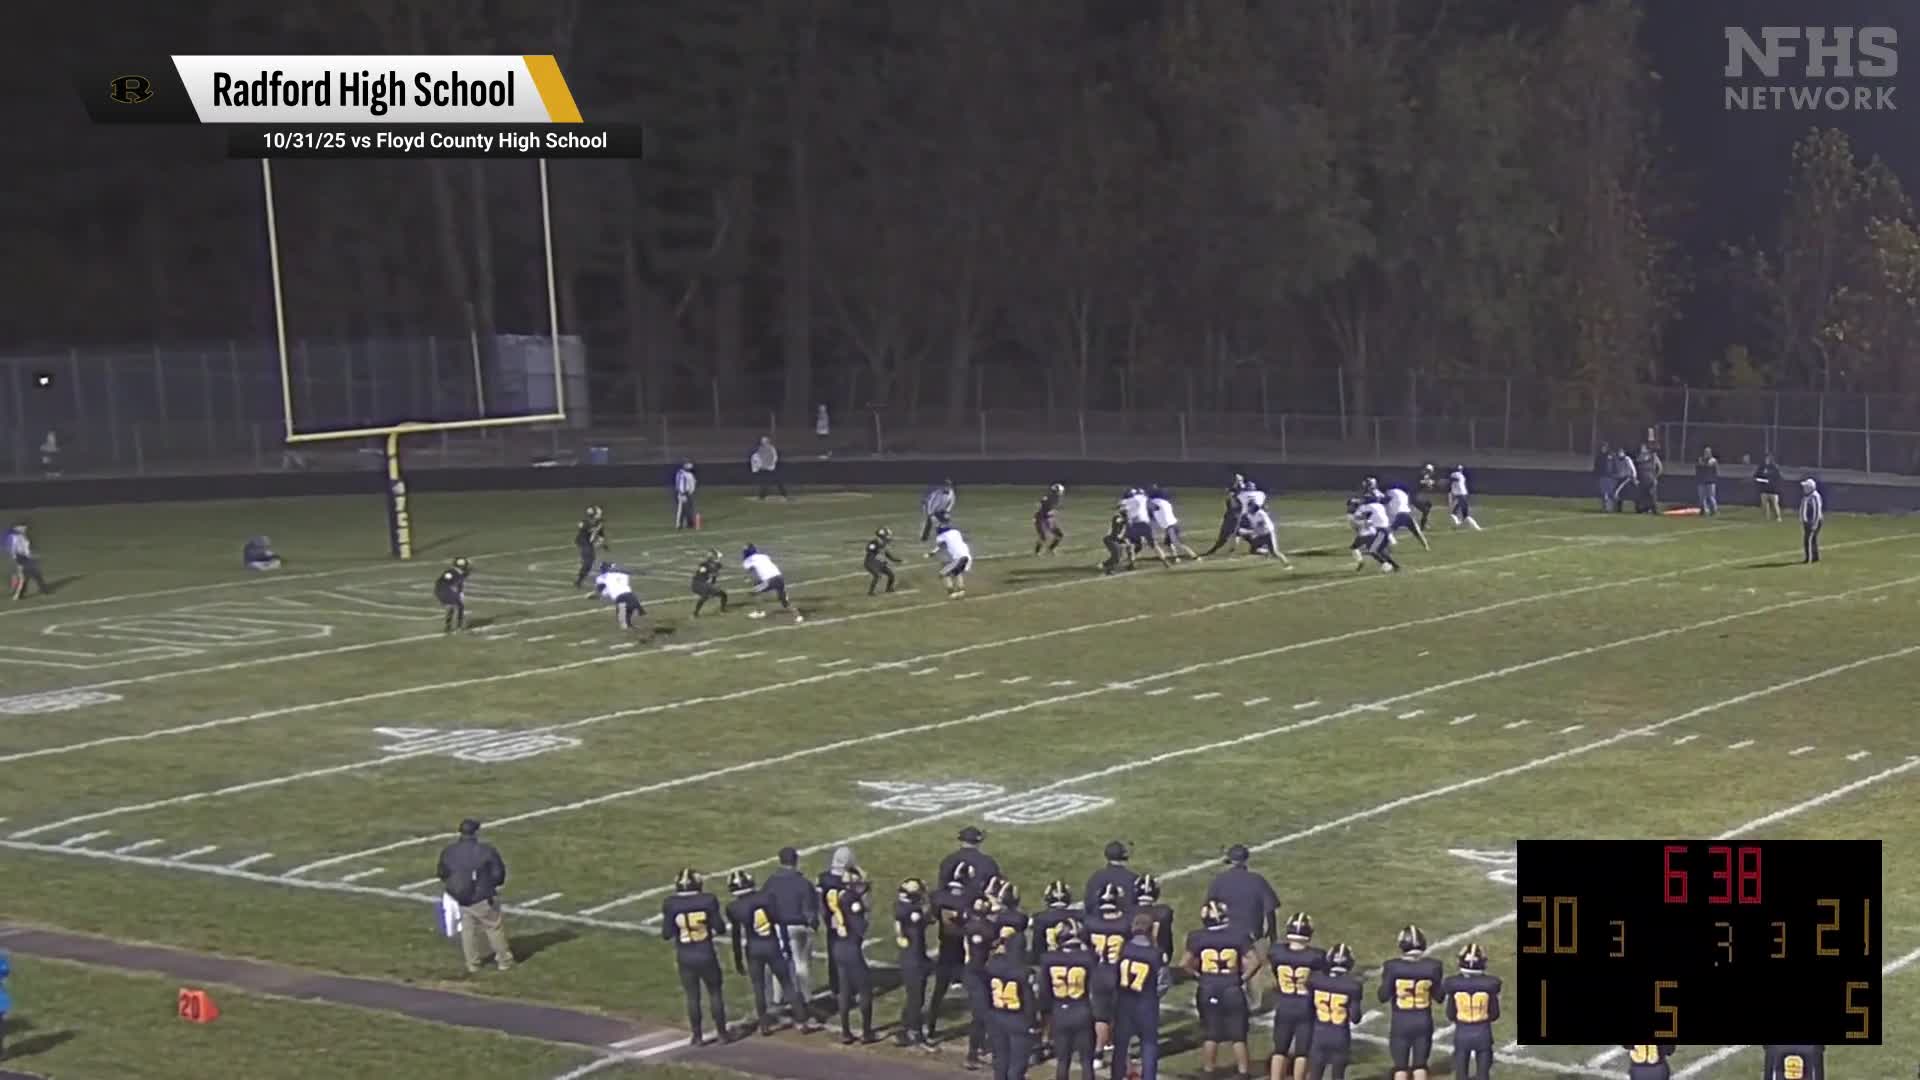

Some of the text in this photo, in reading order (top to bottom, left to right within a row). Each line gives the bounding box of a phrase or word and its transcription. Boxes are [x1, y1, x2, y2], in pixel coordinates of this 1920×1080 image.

[674, 910, 708, 944] 15
[1048, 966, 1087, 999] 50
[1119, 958, 1149, 992] 17
[179, 990, 201, 1020] 20
[1313, 989, 1349, 1025] 55
